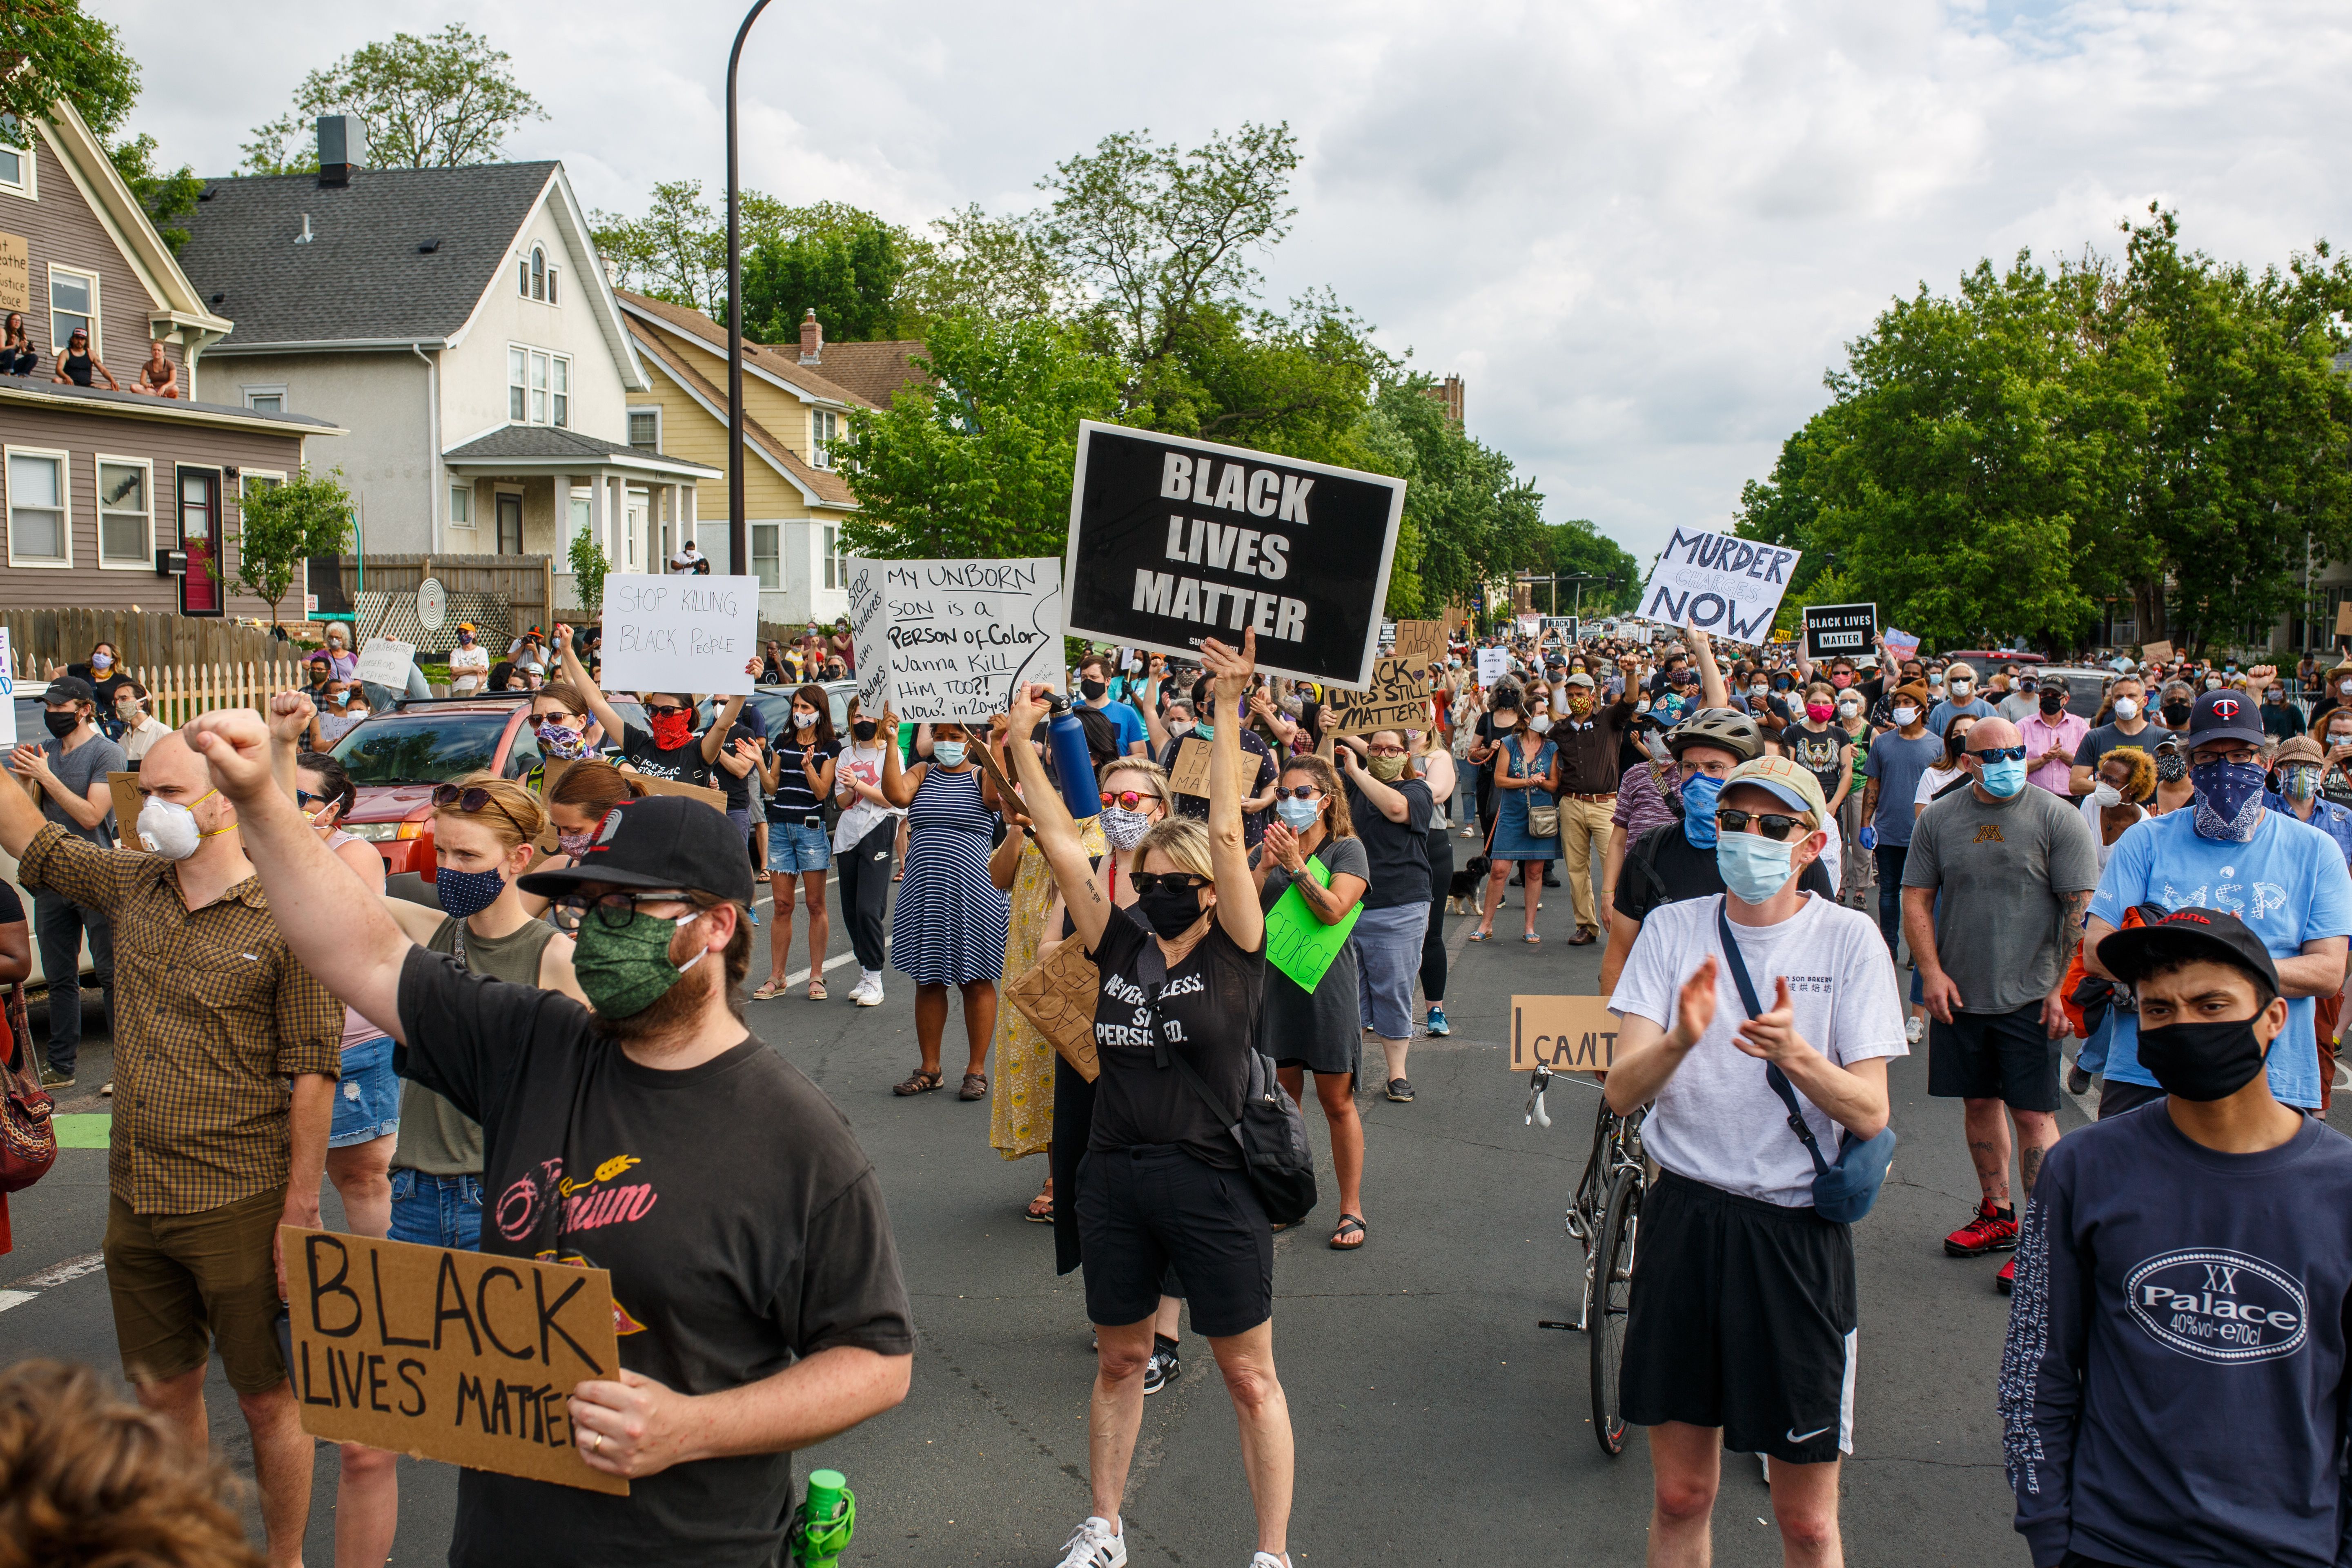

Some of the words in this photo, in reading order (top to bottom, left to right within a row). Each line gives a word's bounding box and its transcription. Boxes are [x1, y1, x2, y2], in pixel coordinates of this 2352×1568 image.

[1160, 452, 1315, 525] BLACK
[1165, 515, 1290, 580] LIVES
[1663, 528, 1792, 584] MURDER
[849, 569, 871, 610] STOP
[928, 563, 1035, 590] UNBORN
[1676, 568, 1761, 603] CHARGES
[682, 589, 737, 618] KILLING
[851, 591, 881, 641] Murderers
[889, 600, 933, 617] SON
[949, 601, 964, 616] is
[974, 601, 994, 617] a
[1132, 568, 1307, 643] MATTER
[1648, 586, 1774, 639] NOW
[1809, 617, 1841, 628] BLACK
[1844, 615, 1871, 626] LIVES
[619, 625, 677, 655] BLACK
[887, 626, 957, 650] PERSON
[988, 624, 1038, 645] Color
[1402, 621, 1443, 642] FUCK
[1823, 635, 1859, 645] MATTER
[859, 665, 885, 708] Badges
[1329, 684, 1378, 710] LIVES
[1385, 683, 1429, 701] STILL
[1265, 912, 1331, 987] GEORGE
[1515, 1007, 1522, 1063] I
[2201, 1263, 2239, 1294] XX
[305, 1234, 604, 1375] BLACK
[2142, 1285, 2298, 1330] Palace
[301, 1341, 426, 1417] LIVES
